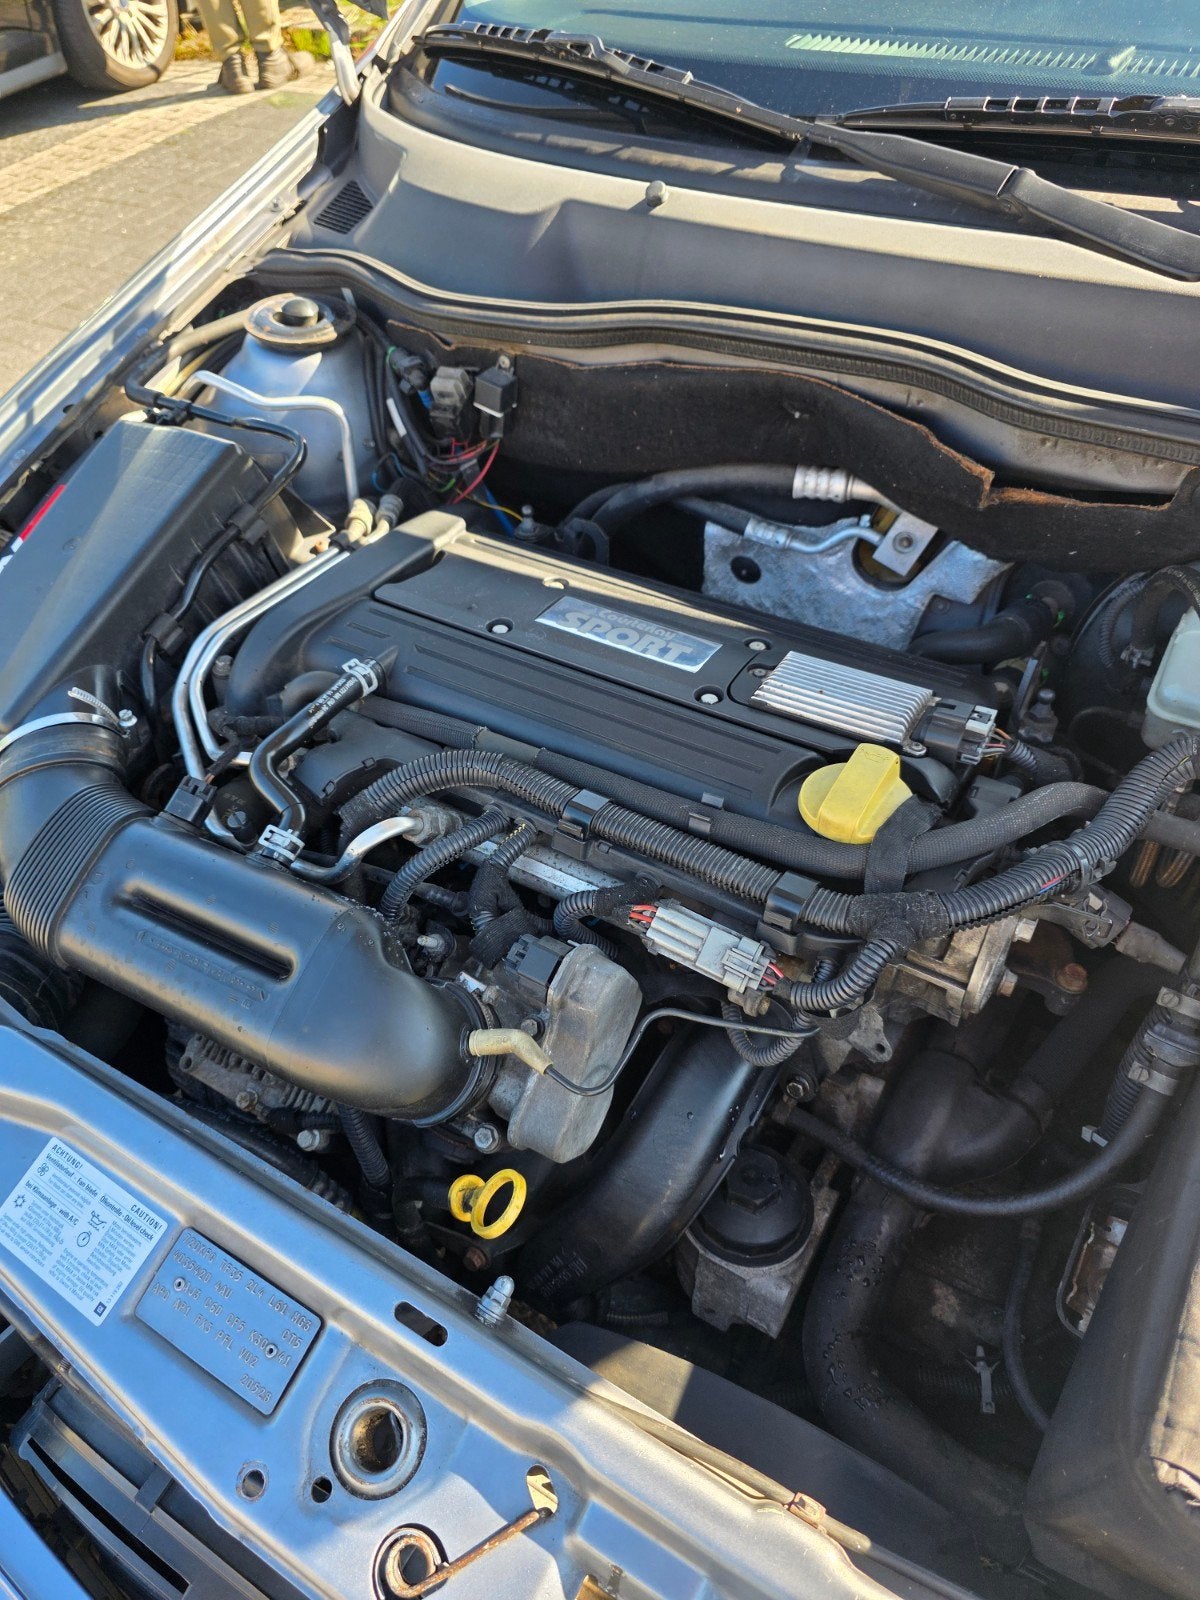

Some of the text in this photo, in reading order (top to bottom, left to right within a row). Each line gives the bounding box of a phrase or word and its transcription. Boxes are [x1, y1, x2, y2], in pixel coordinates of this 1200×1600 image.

[558, 611, 694, 663] SPORT
[52, 1144, 83, 1170] ACHTUNG!
[76, 1177, 87, 1188] Fan
[130, 1204, 163, 1231] CAUTION!
